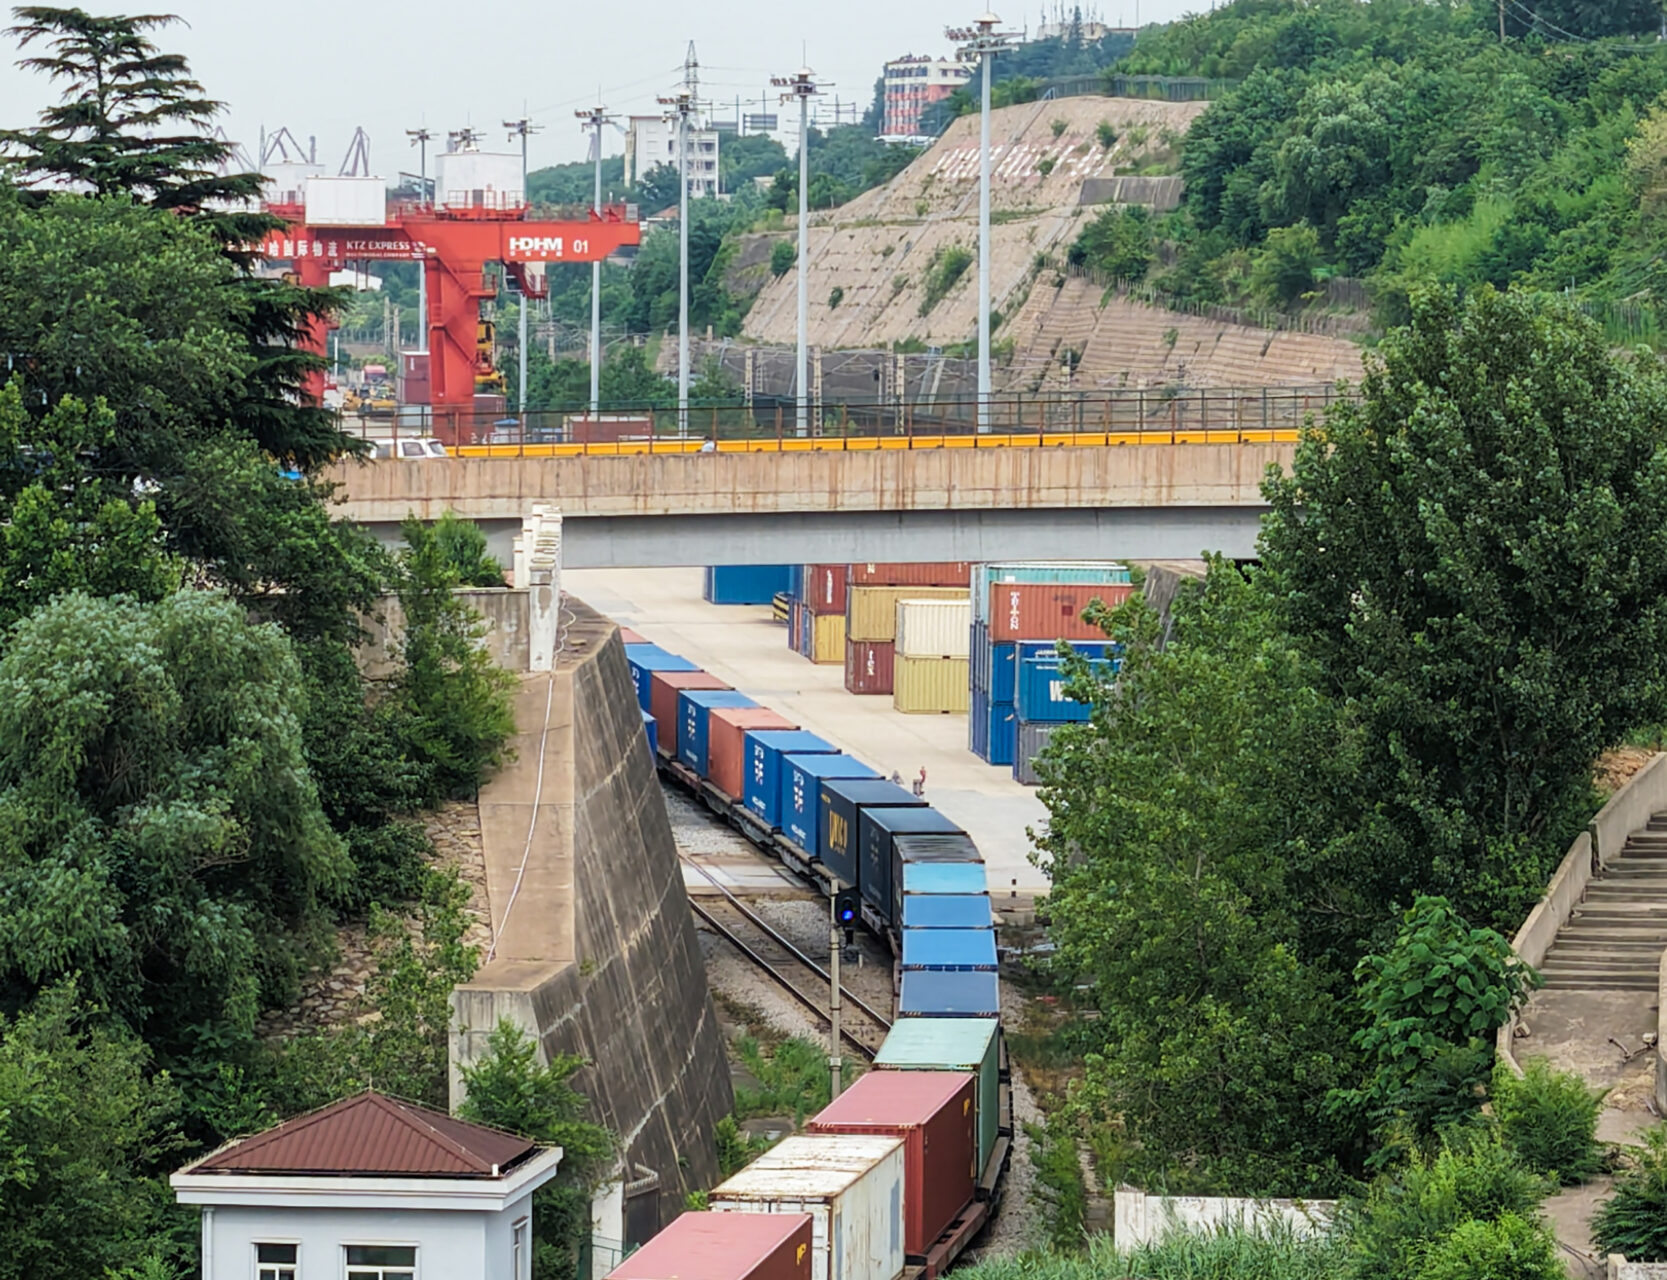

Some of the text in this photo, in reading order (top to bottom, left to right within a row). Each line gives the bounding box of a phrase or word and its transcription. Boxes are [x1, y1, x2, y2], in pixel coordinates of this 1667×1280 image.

[346, 241, 410, 250] KTZ EXPRESS
[509, 237, 563, 250] HDHM
[573, 239, 589, 254] 01
